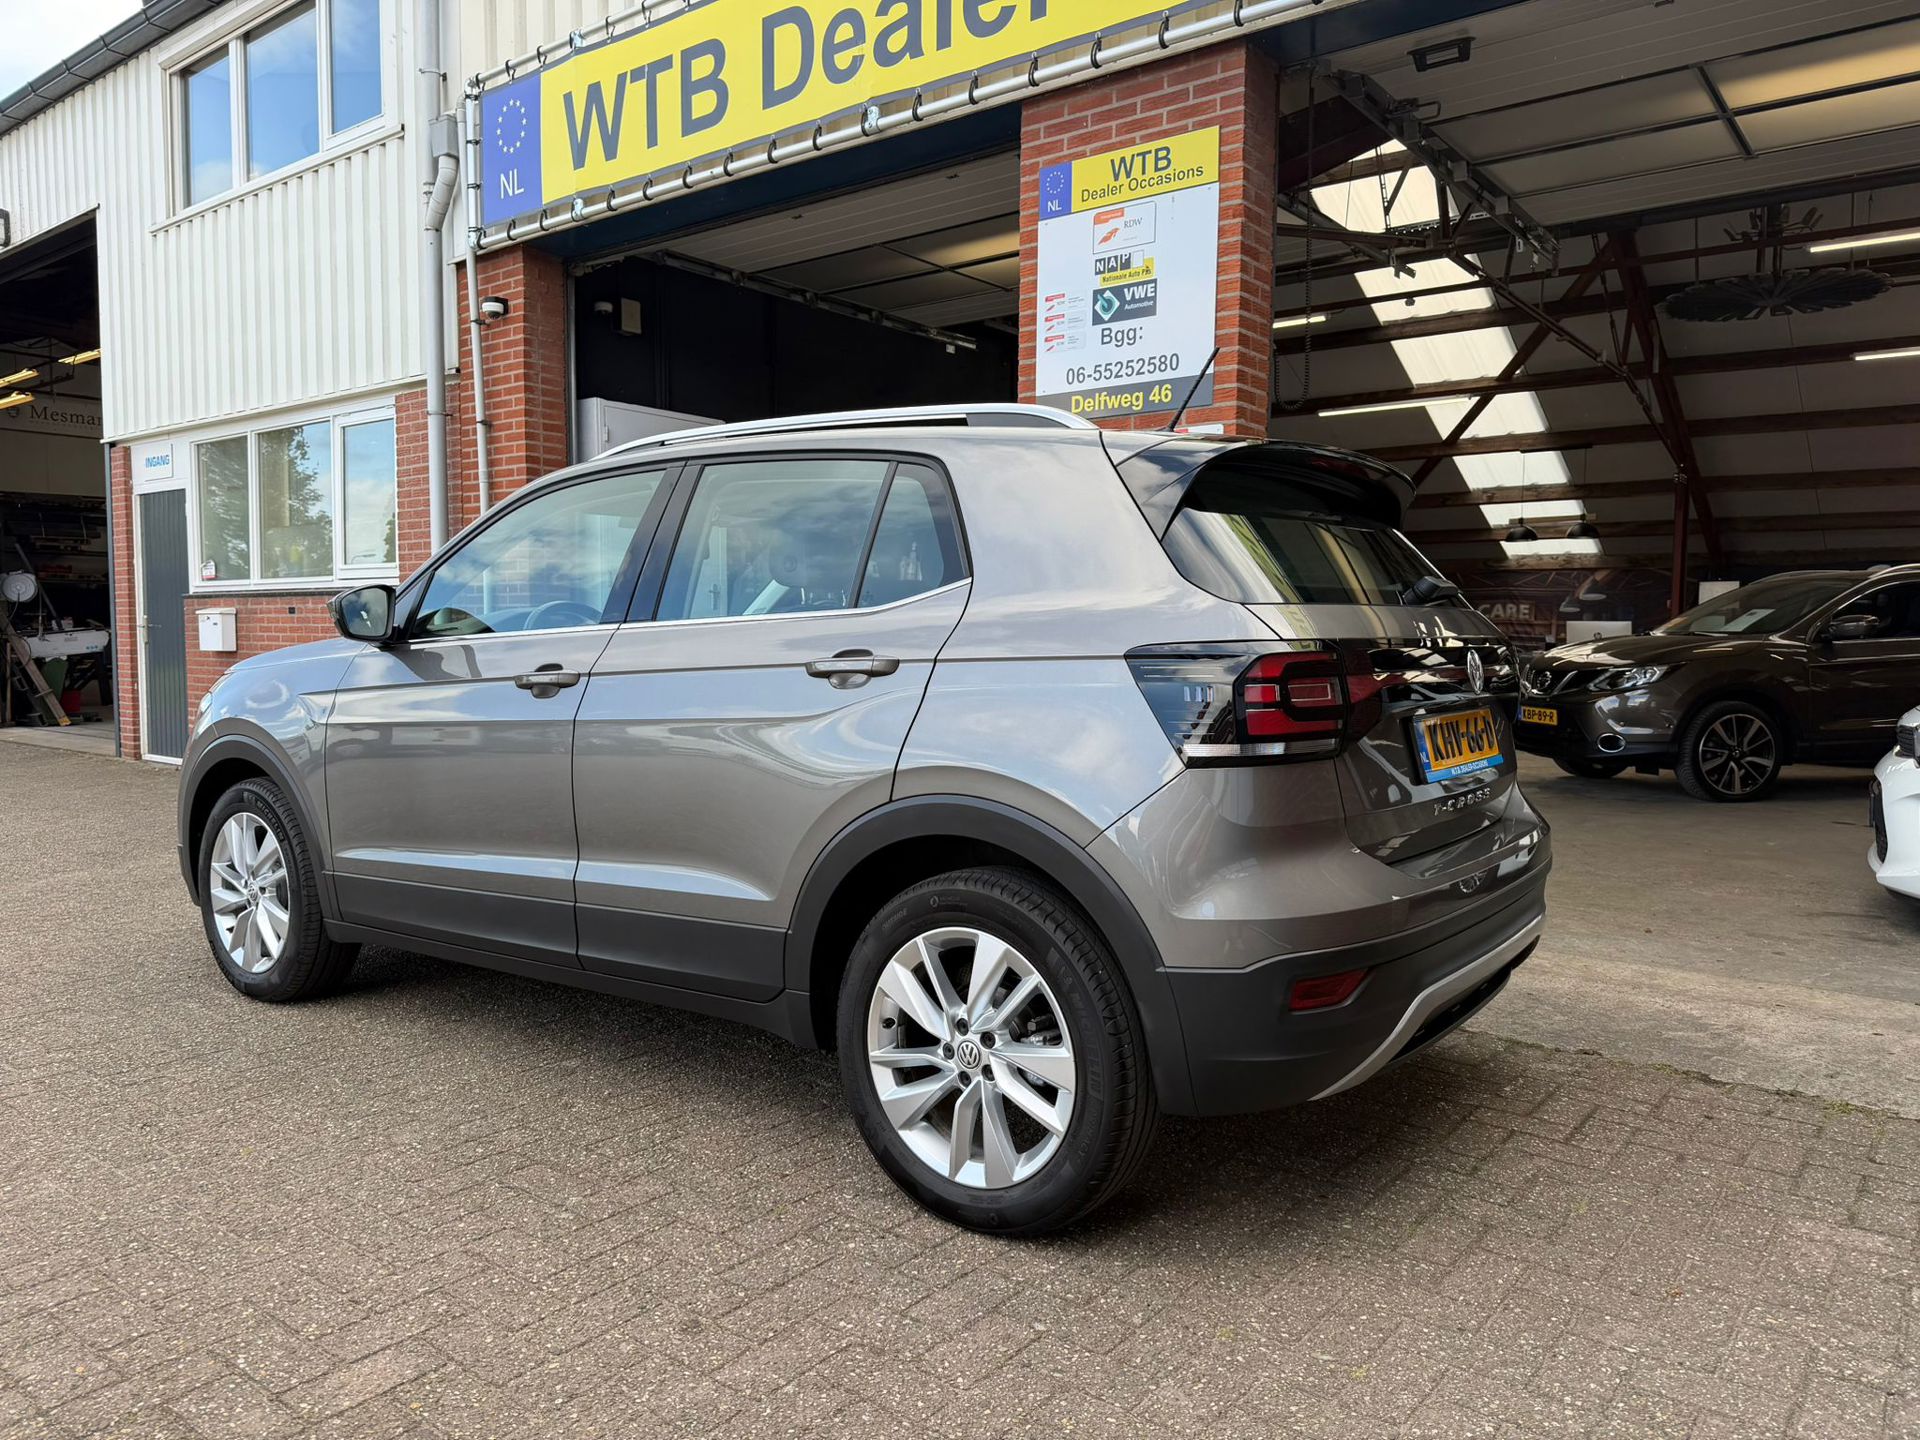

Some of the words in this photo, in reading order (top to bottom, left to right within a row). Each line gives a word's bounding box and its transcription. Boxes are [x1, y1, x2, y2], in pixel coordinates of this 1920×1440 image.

[562, 37, 730, 172] WTB
[1110, 145, 1172, 182] WTB
[499, 170, 525, 200] NL
[1081, 183, 1124, 203] Dealer
[1128, 166, 1204, 191] Occasions
[1047, 199, 1062, 213] NL
[1123, 216, 1143, 229] RDW
[1102, 273, 1127, 283] Nationale
[1128, 269, 1140, 278] Auto
[1123, 283, 1156, 301] VWE
[1124, 300, 1154, 311] Automotive
[1101, 326, 1144, 348] Bgg:
[1066, 352, 1180, 385] 06-55252580
[1071, 388, 1144, 414] Delfweg
[1149, 382, 1172, 403] 46
[145, 454, 170, 468] INGANG
[1522, 708, 1554, 723] KBP-89-R
[1424, 716, 1495, 762] KHV-66-D
[1433, 787, 1491, 817] T-CROSS
